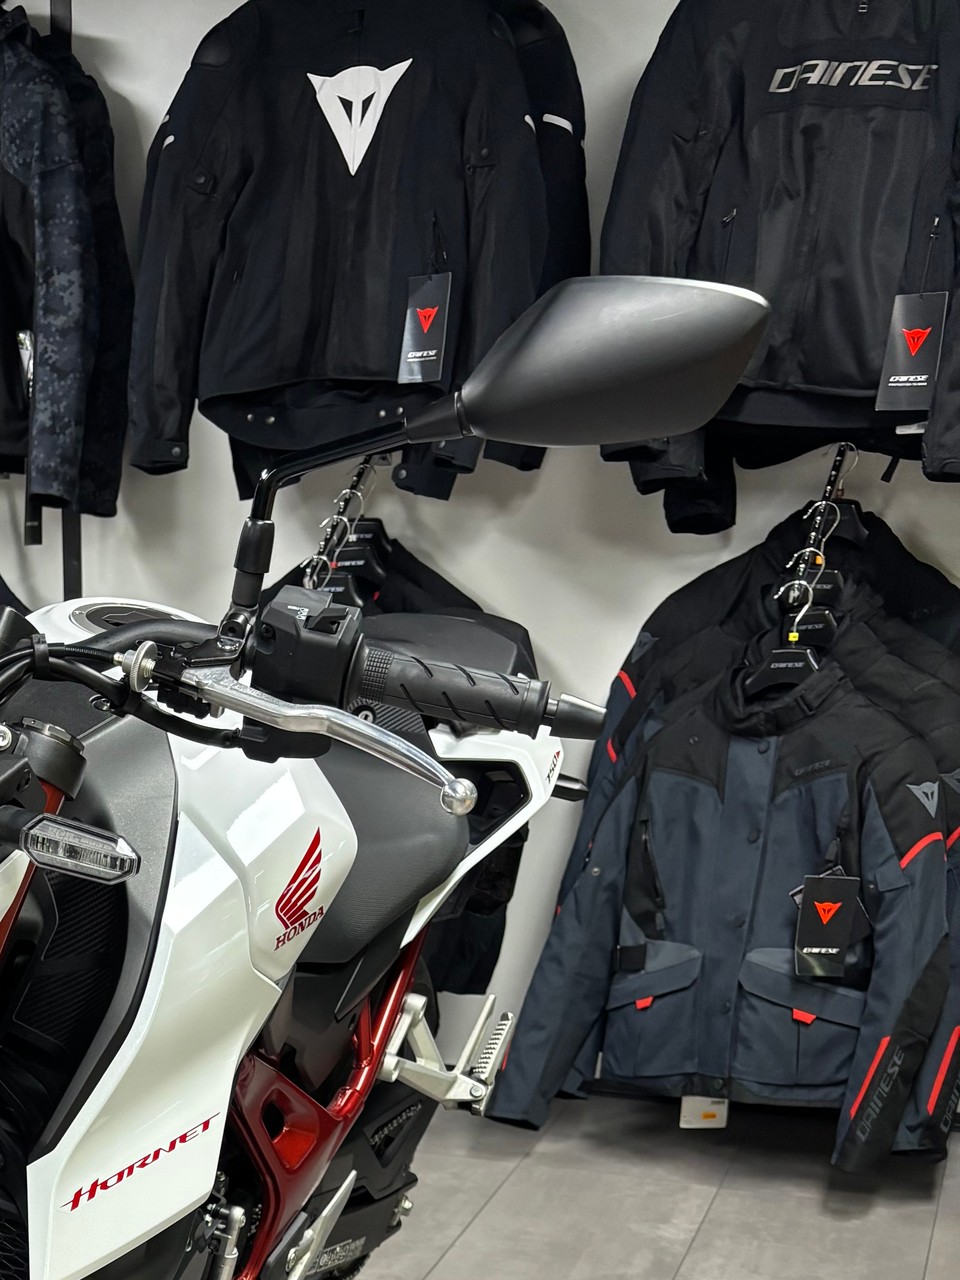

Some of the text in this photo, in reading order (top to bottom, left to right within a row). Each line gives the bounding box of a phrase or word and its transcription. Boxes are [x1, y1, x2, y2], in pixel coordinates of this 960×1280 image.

[768, 60, 938, 93] DAINESE
[273, 905, 325, 951] HONDA
[855, 1046, 905, 1142] DAINESE
[60, 1112, 221, 1212] HORNET
